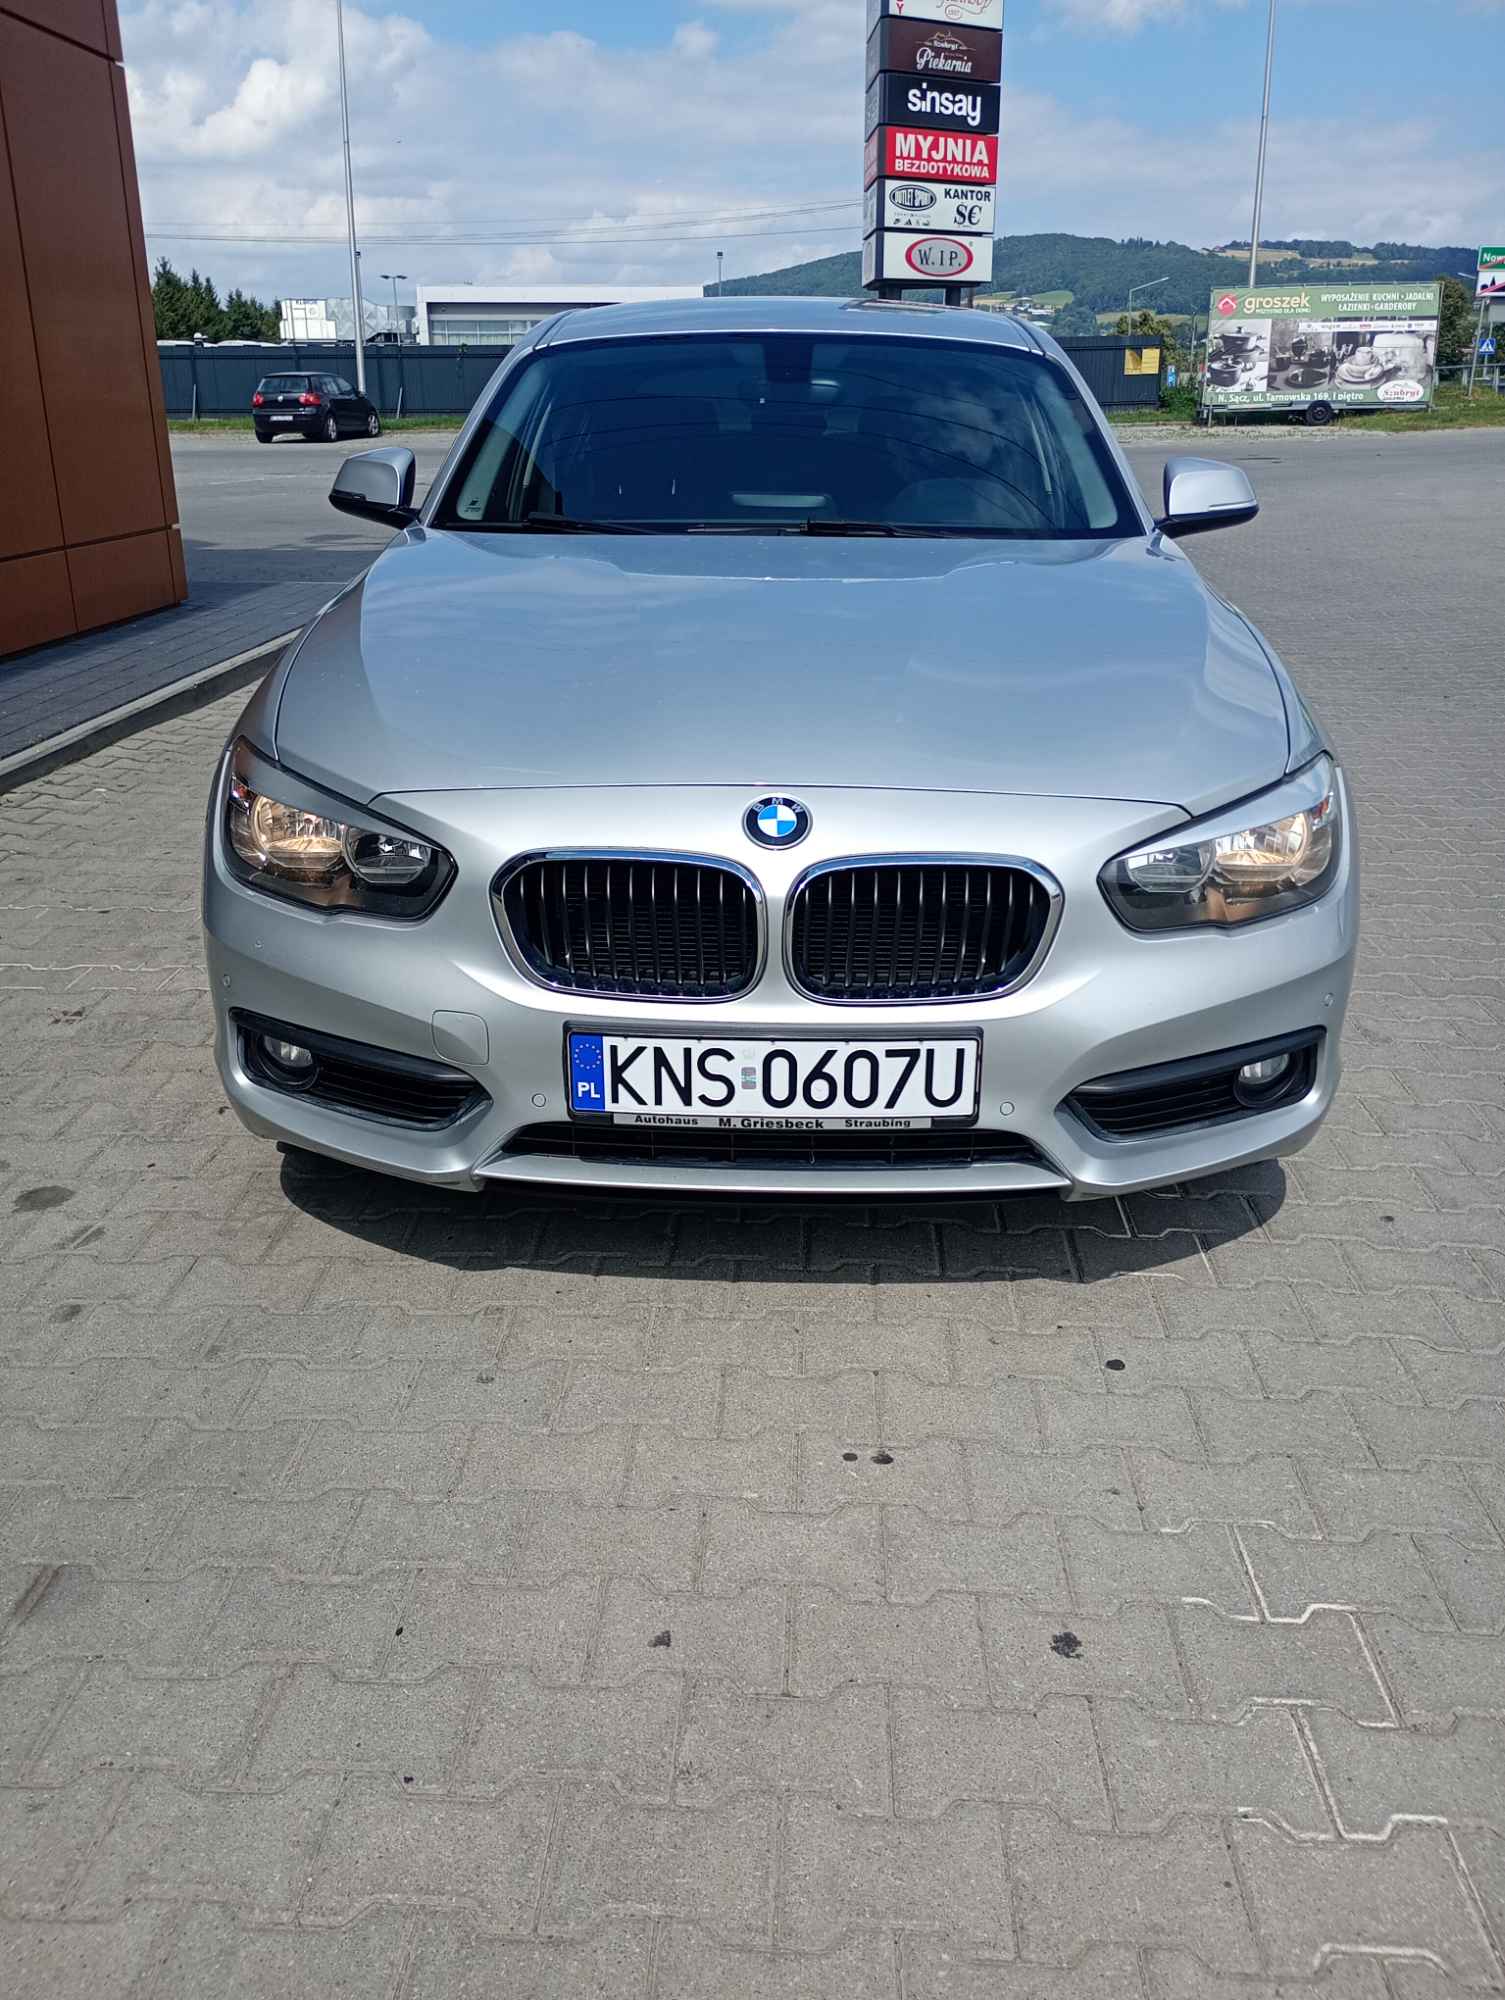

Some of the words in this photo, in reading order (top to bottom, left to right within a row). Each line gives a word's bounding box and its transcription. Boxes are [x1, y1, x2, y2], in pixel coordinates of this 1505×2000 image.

[916, 47, 972, 72] Piekarnia
[907, 82, 981, 126] sinsay
[895, 133, 989, 164] MYJNIA
[894, 159, 990, 178] BEZDOTYKOWA
[944, 188, 991, 202] KANTOR
[1243, 292, 1311, 314] groszek
[1372, 292, 1399, 301] KUCHNI
[1266, 392, 1311, 401] Tarnowska
[751, 797, 804, 814] BMW
[609, 1044, 735, 1107] KNS
[761, 1048, 966, 1110] 0607U
[577, 1082, 601, 1098] PL
[634, 1115, 699, 1126] Autohaus
[718, 1117, 737, 1128] M.
[740, 1118, 824, 1130] Griesbeck
[844, 1119, 911, 1129] Straubing
